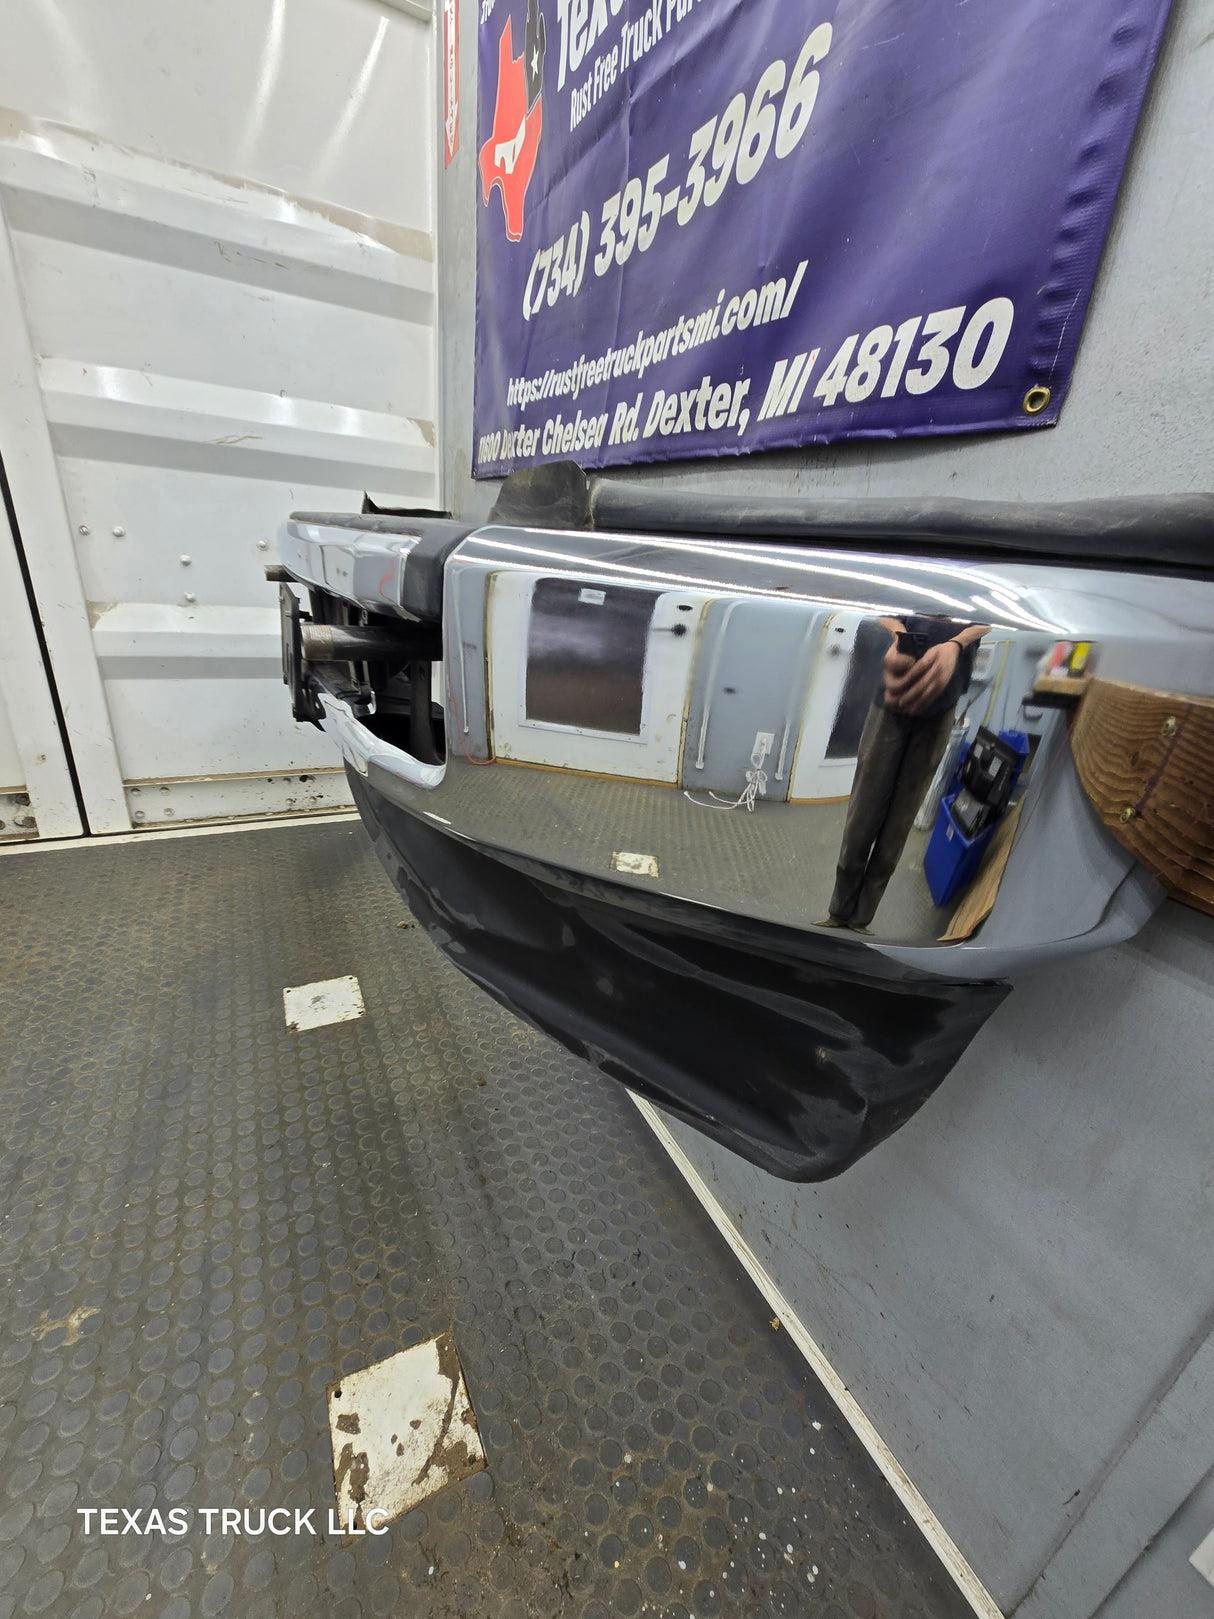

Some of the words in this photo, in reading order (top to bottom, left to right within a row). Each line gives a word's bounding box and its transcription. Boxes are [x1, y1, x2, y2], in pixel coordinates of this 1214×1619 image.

[557, 0, 623, 93] Tex
[570, 72, 593, 133] Rust
[593, 45, 619, 106] Free
[620, 0, 663, 74] Truck
[523, 210, 590, 321] (734)
[594, 22, 833, 277] 395-3966
[500, 424, 541, 460] Dexter
[541, 409, 609, 455] Chelsea
[608, 392, 644, 445] Rd.
[642, 376, 751, 436] Dexter,
[756, 348, 821, 422] MI
[813, 297, 1014, 407] 48130
[506, 260, 808, 411] https://rustfreetruckpartsmi.com/
